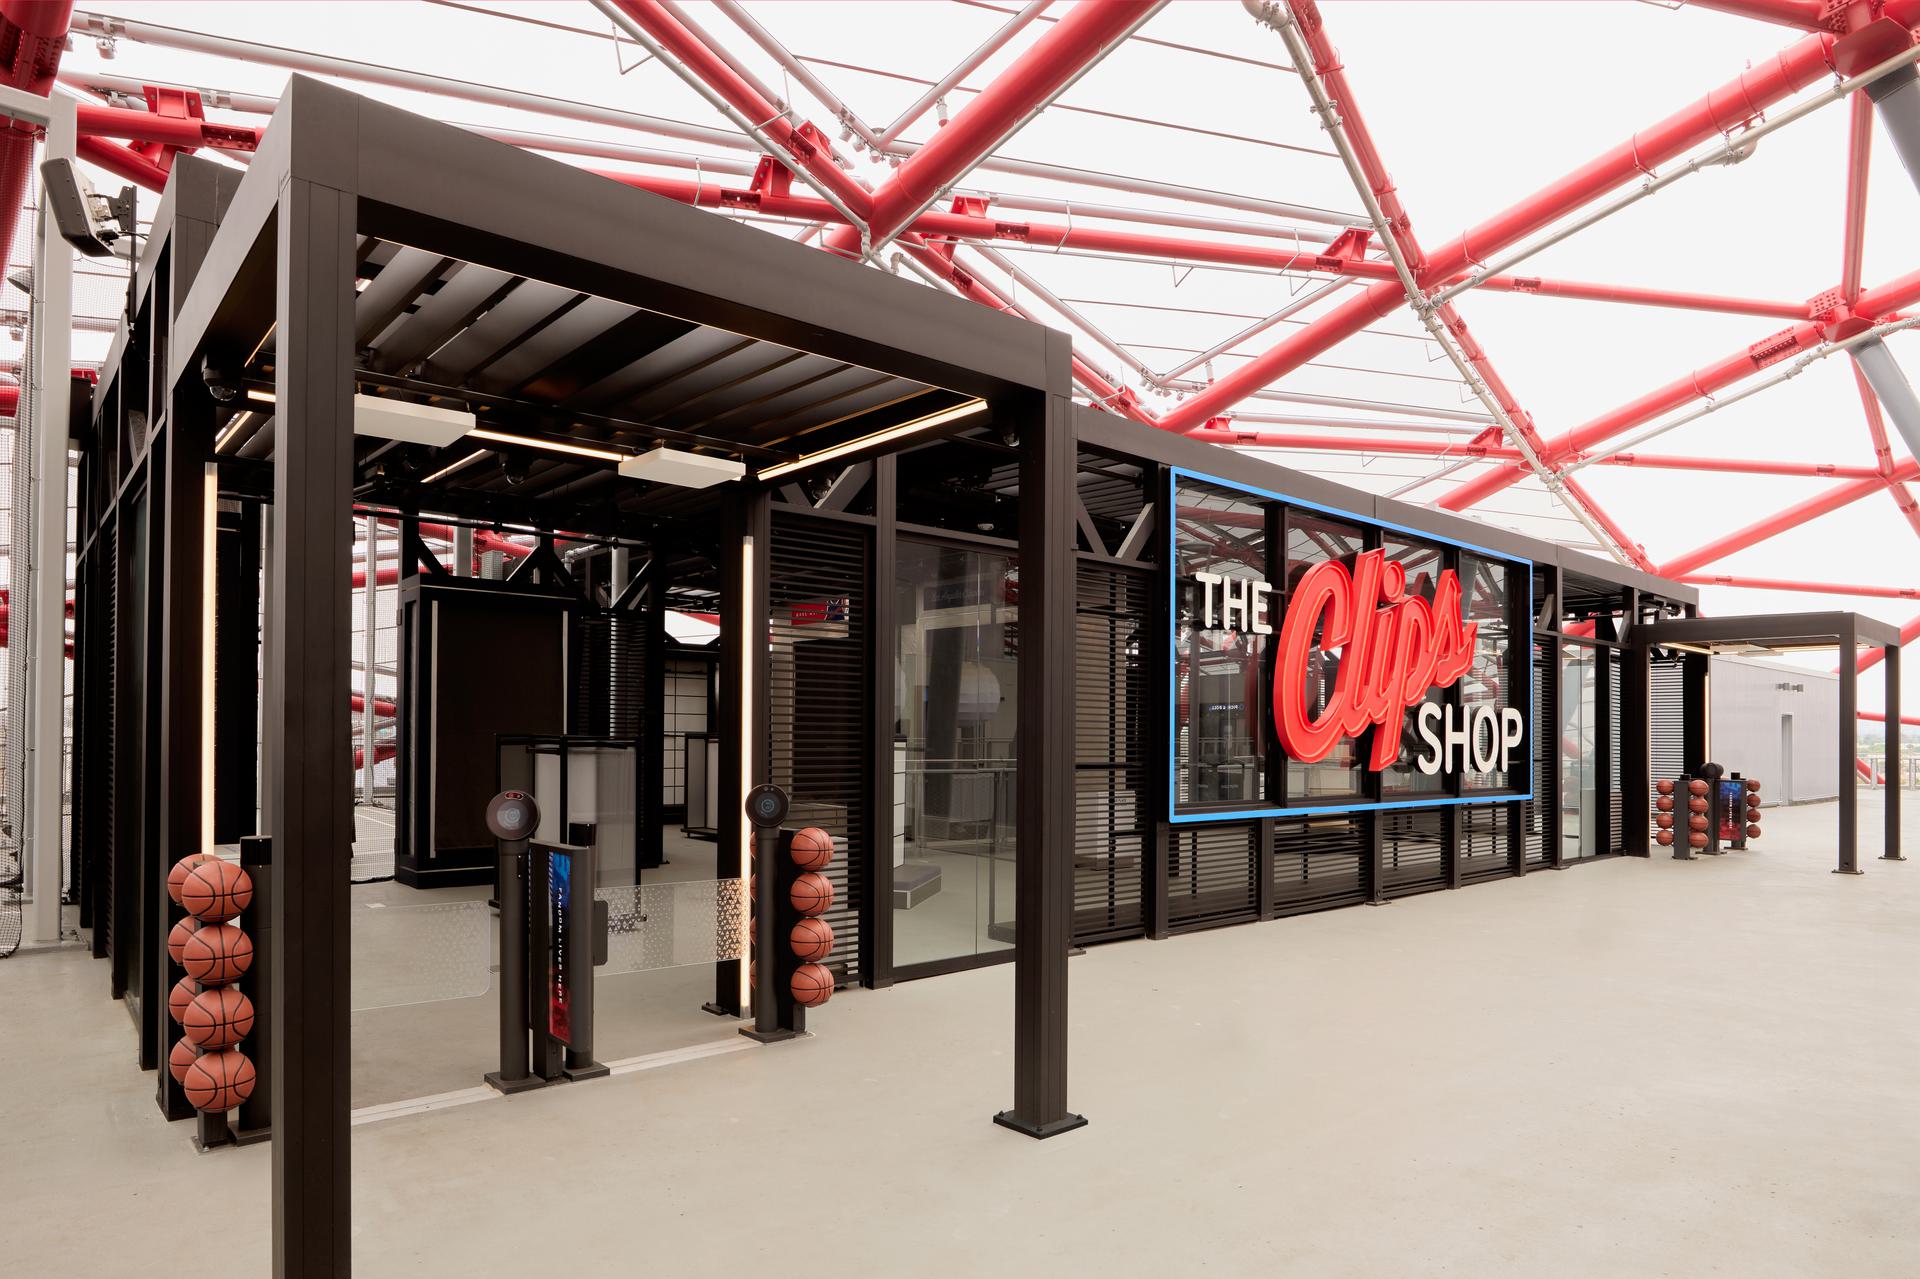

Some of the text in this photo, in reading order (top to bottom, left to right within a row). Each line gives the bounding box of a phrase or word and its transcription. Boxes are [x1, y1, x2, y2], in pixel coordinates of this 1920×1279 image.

[1195, 571, 1273, 635] THE
[1273, 547, 1478, 772] Clips
[1417, 701, 1523, 776] SHOP
